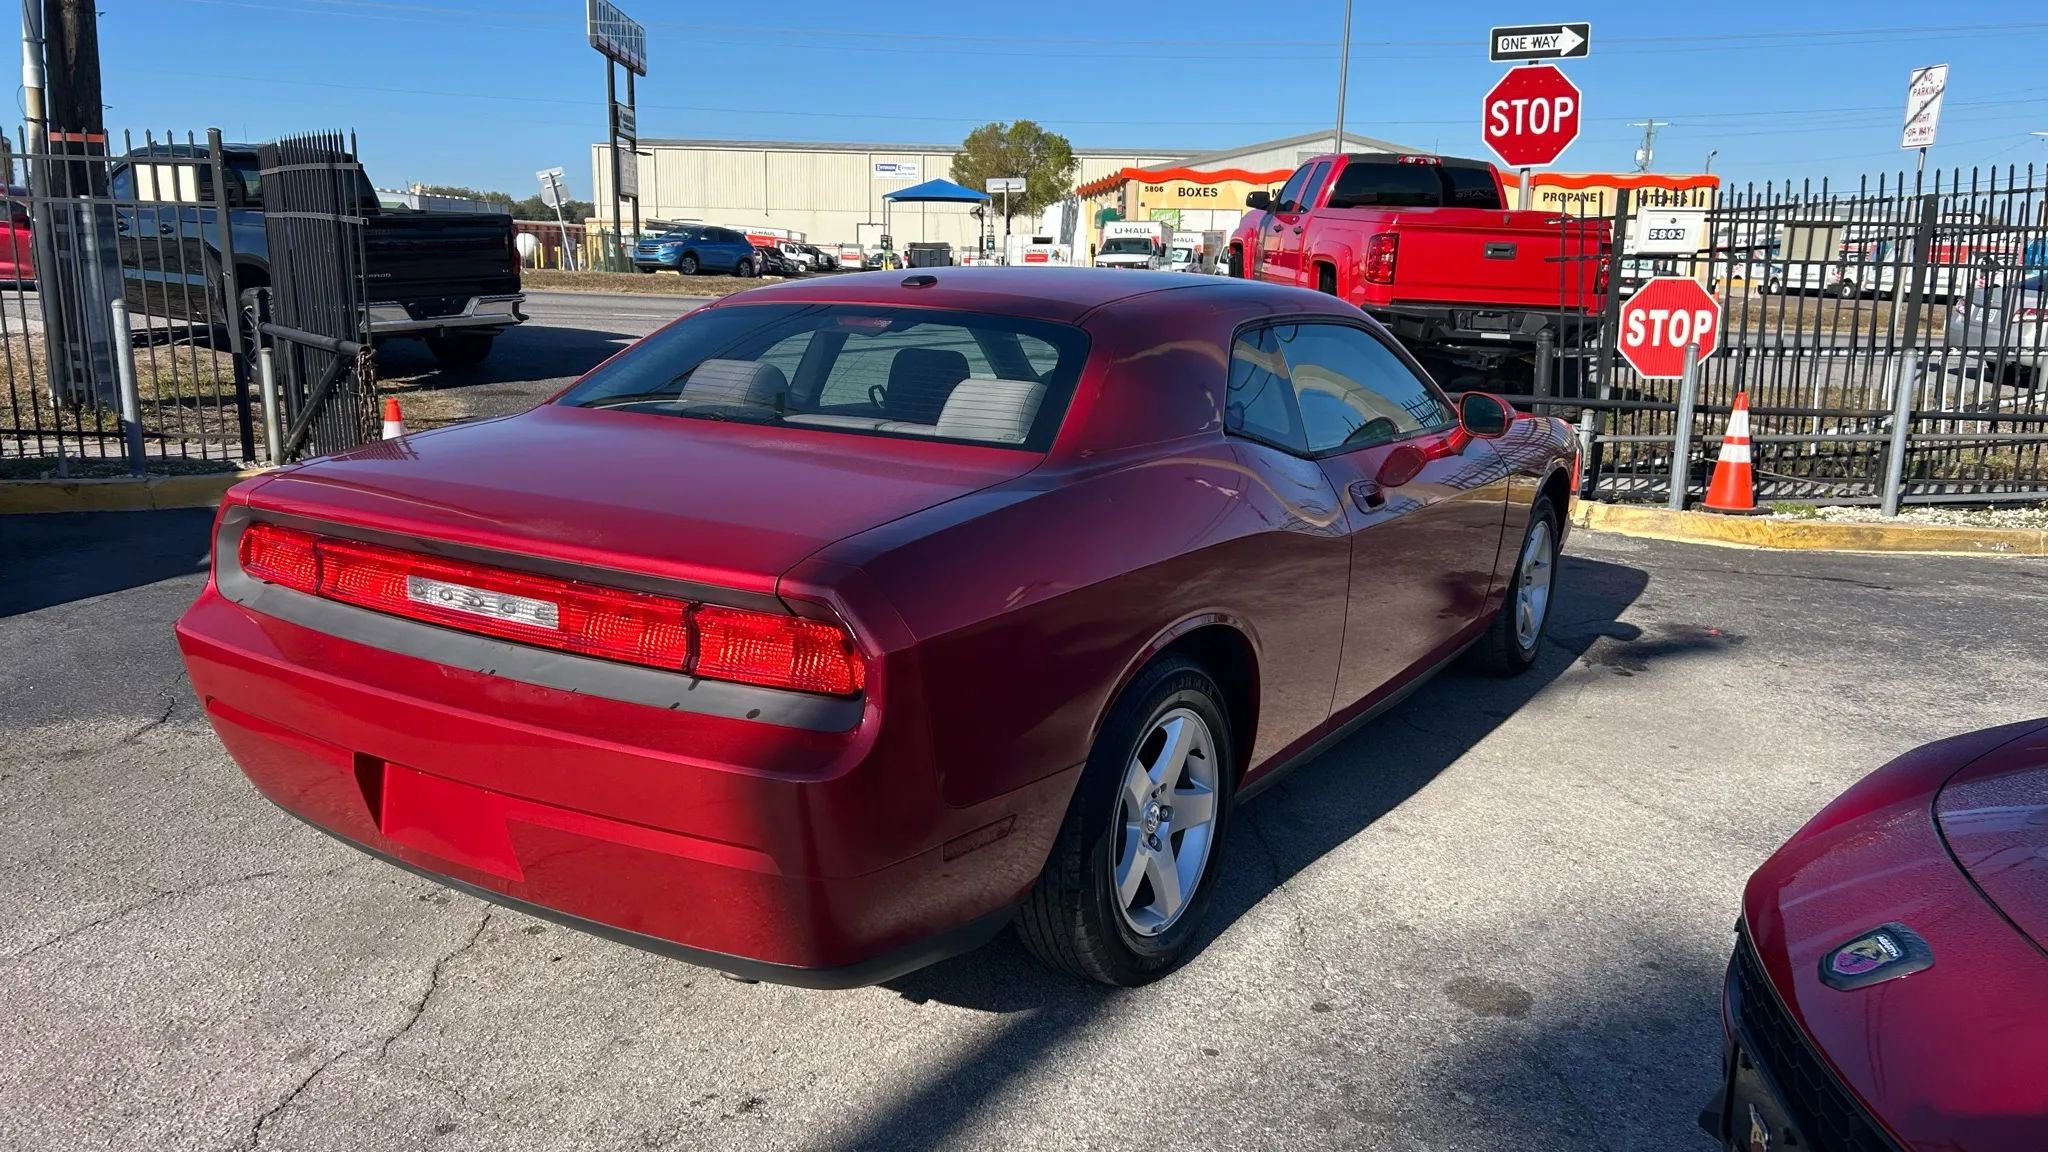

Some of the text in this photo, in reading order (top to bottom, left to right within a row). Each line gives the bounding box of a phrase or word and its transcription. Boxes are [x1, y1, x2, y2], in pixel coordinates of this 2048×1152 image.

[1501, 35, 1560, 50] ONE WAY
[1924, 73, 1933, 82] NO
[1912, 85, 1940, 96] PARKING
[1489, 97, 1574, 137] STOP
[1907, 127, 1932, 137] OF WAY
[1178, 187, 1218, 198] BOXES
[1543, 193, 1597, 203] PROPANE
[1650, 229, 1685, 239] 5803
[1626, 308, 1713, 348] STOP
[412, 583, 557, 621] DODGE
